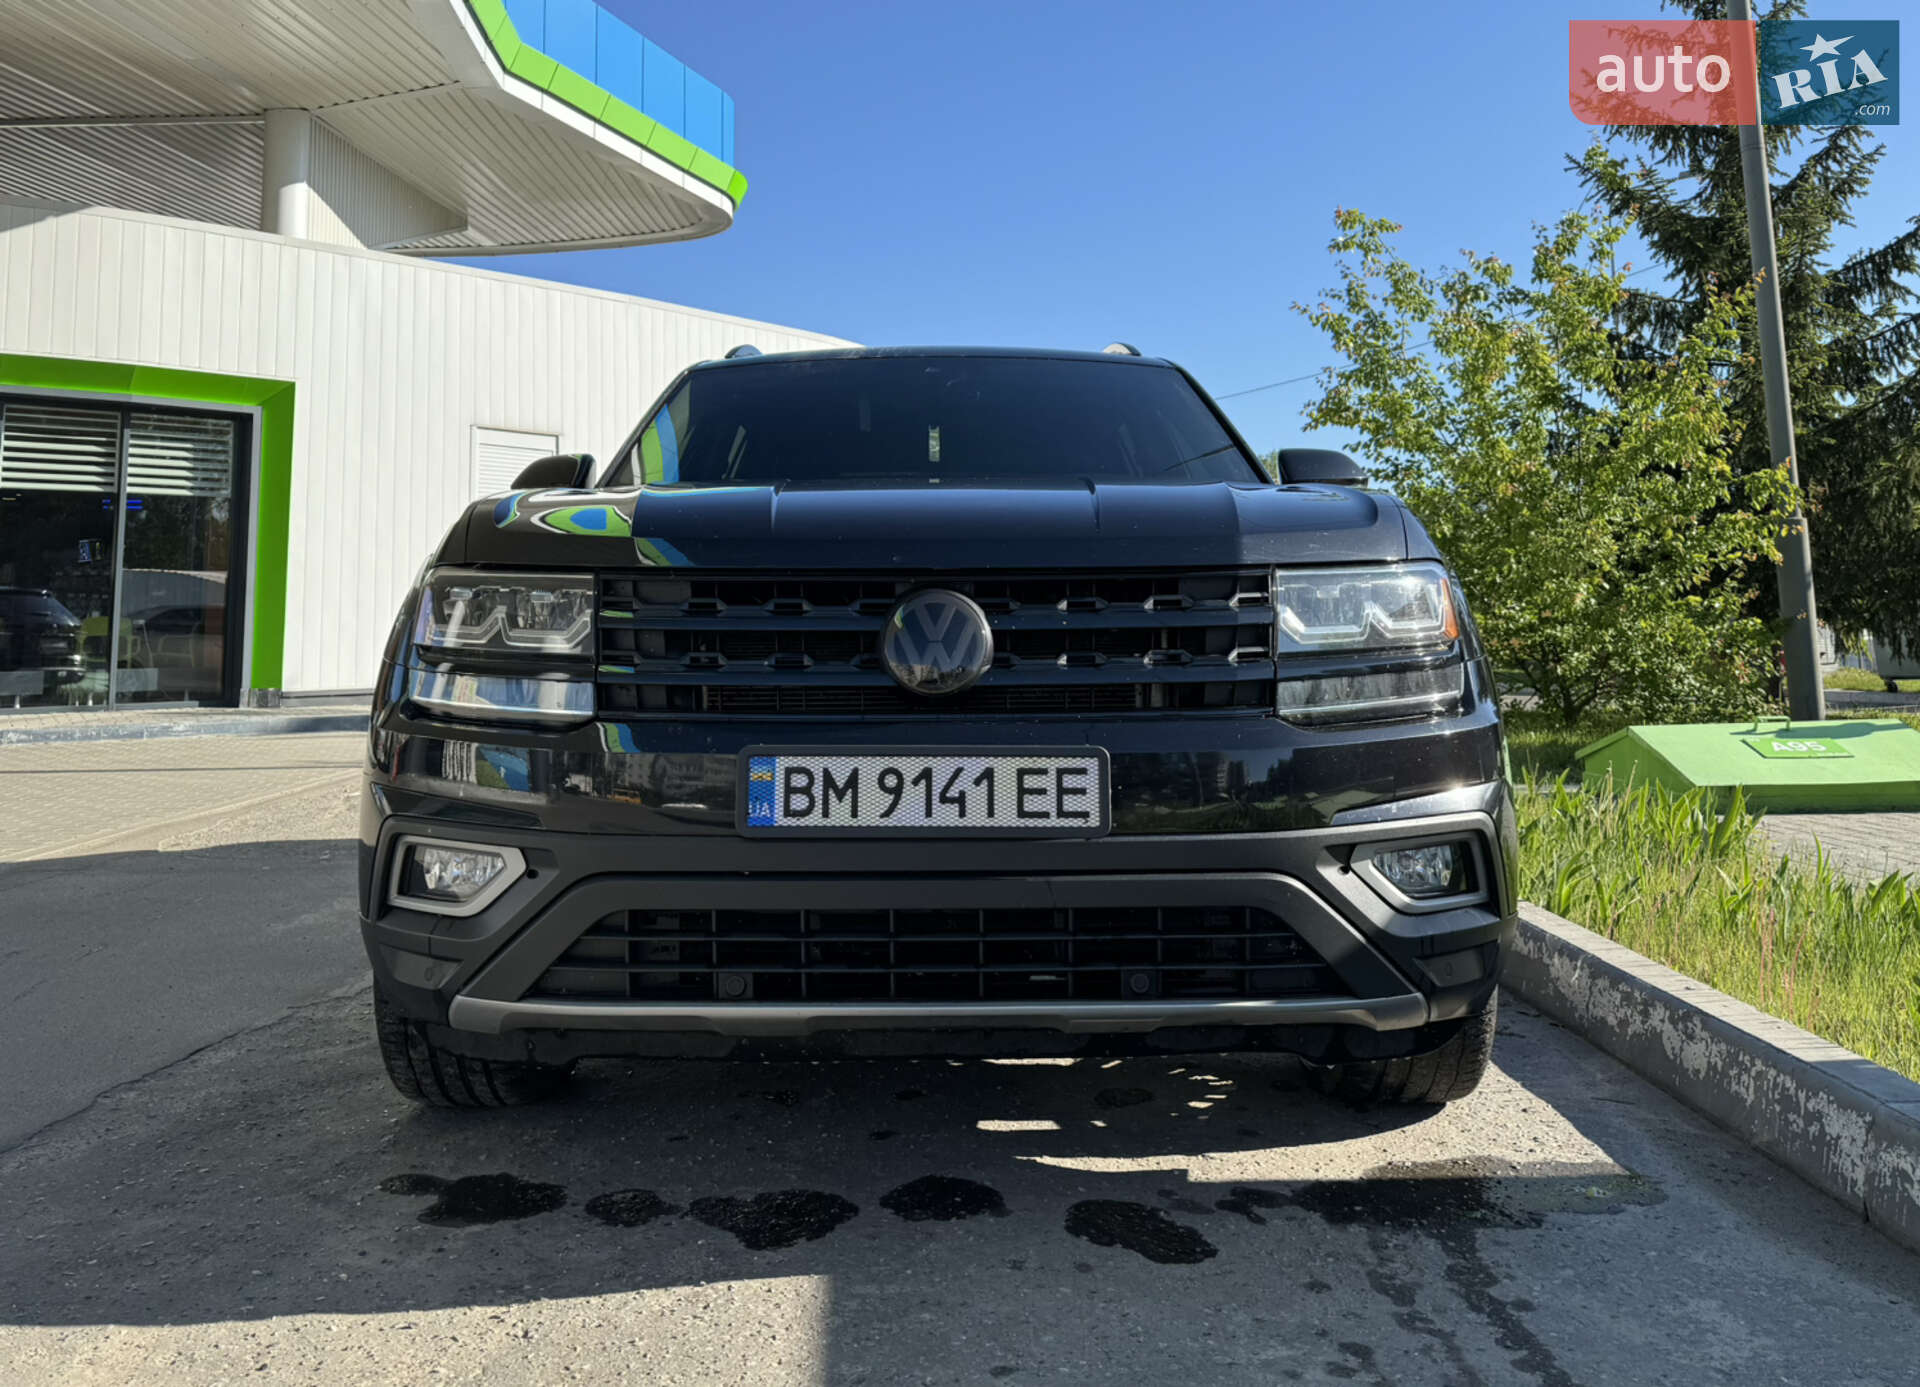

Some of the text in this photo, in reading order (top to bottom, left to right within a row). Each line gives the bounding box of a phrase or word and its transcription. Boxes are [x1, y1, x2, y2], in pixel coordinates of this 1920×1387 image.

[1771, 741, 1827, 753] A95
[783, 766, 1091, 819] BM 9141 EE
[748, 801, 772, 818] UA
